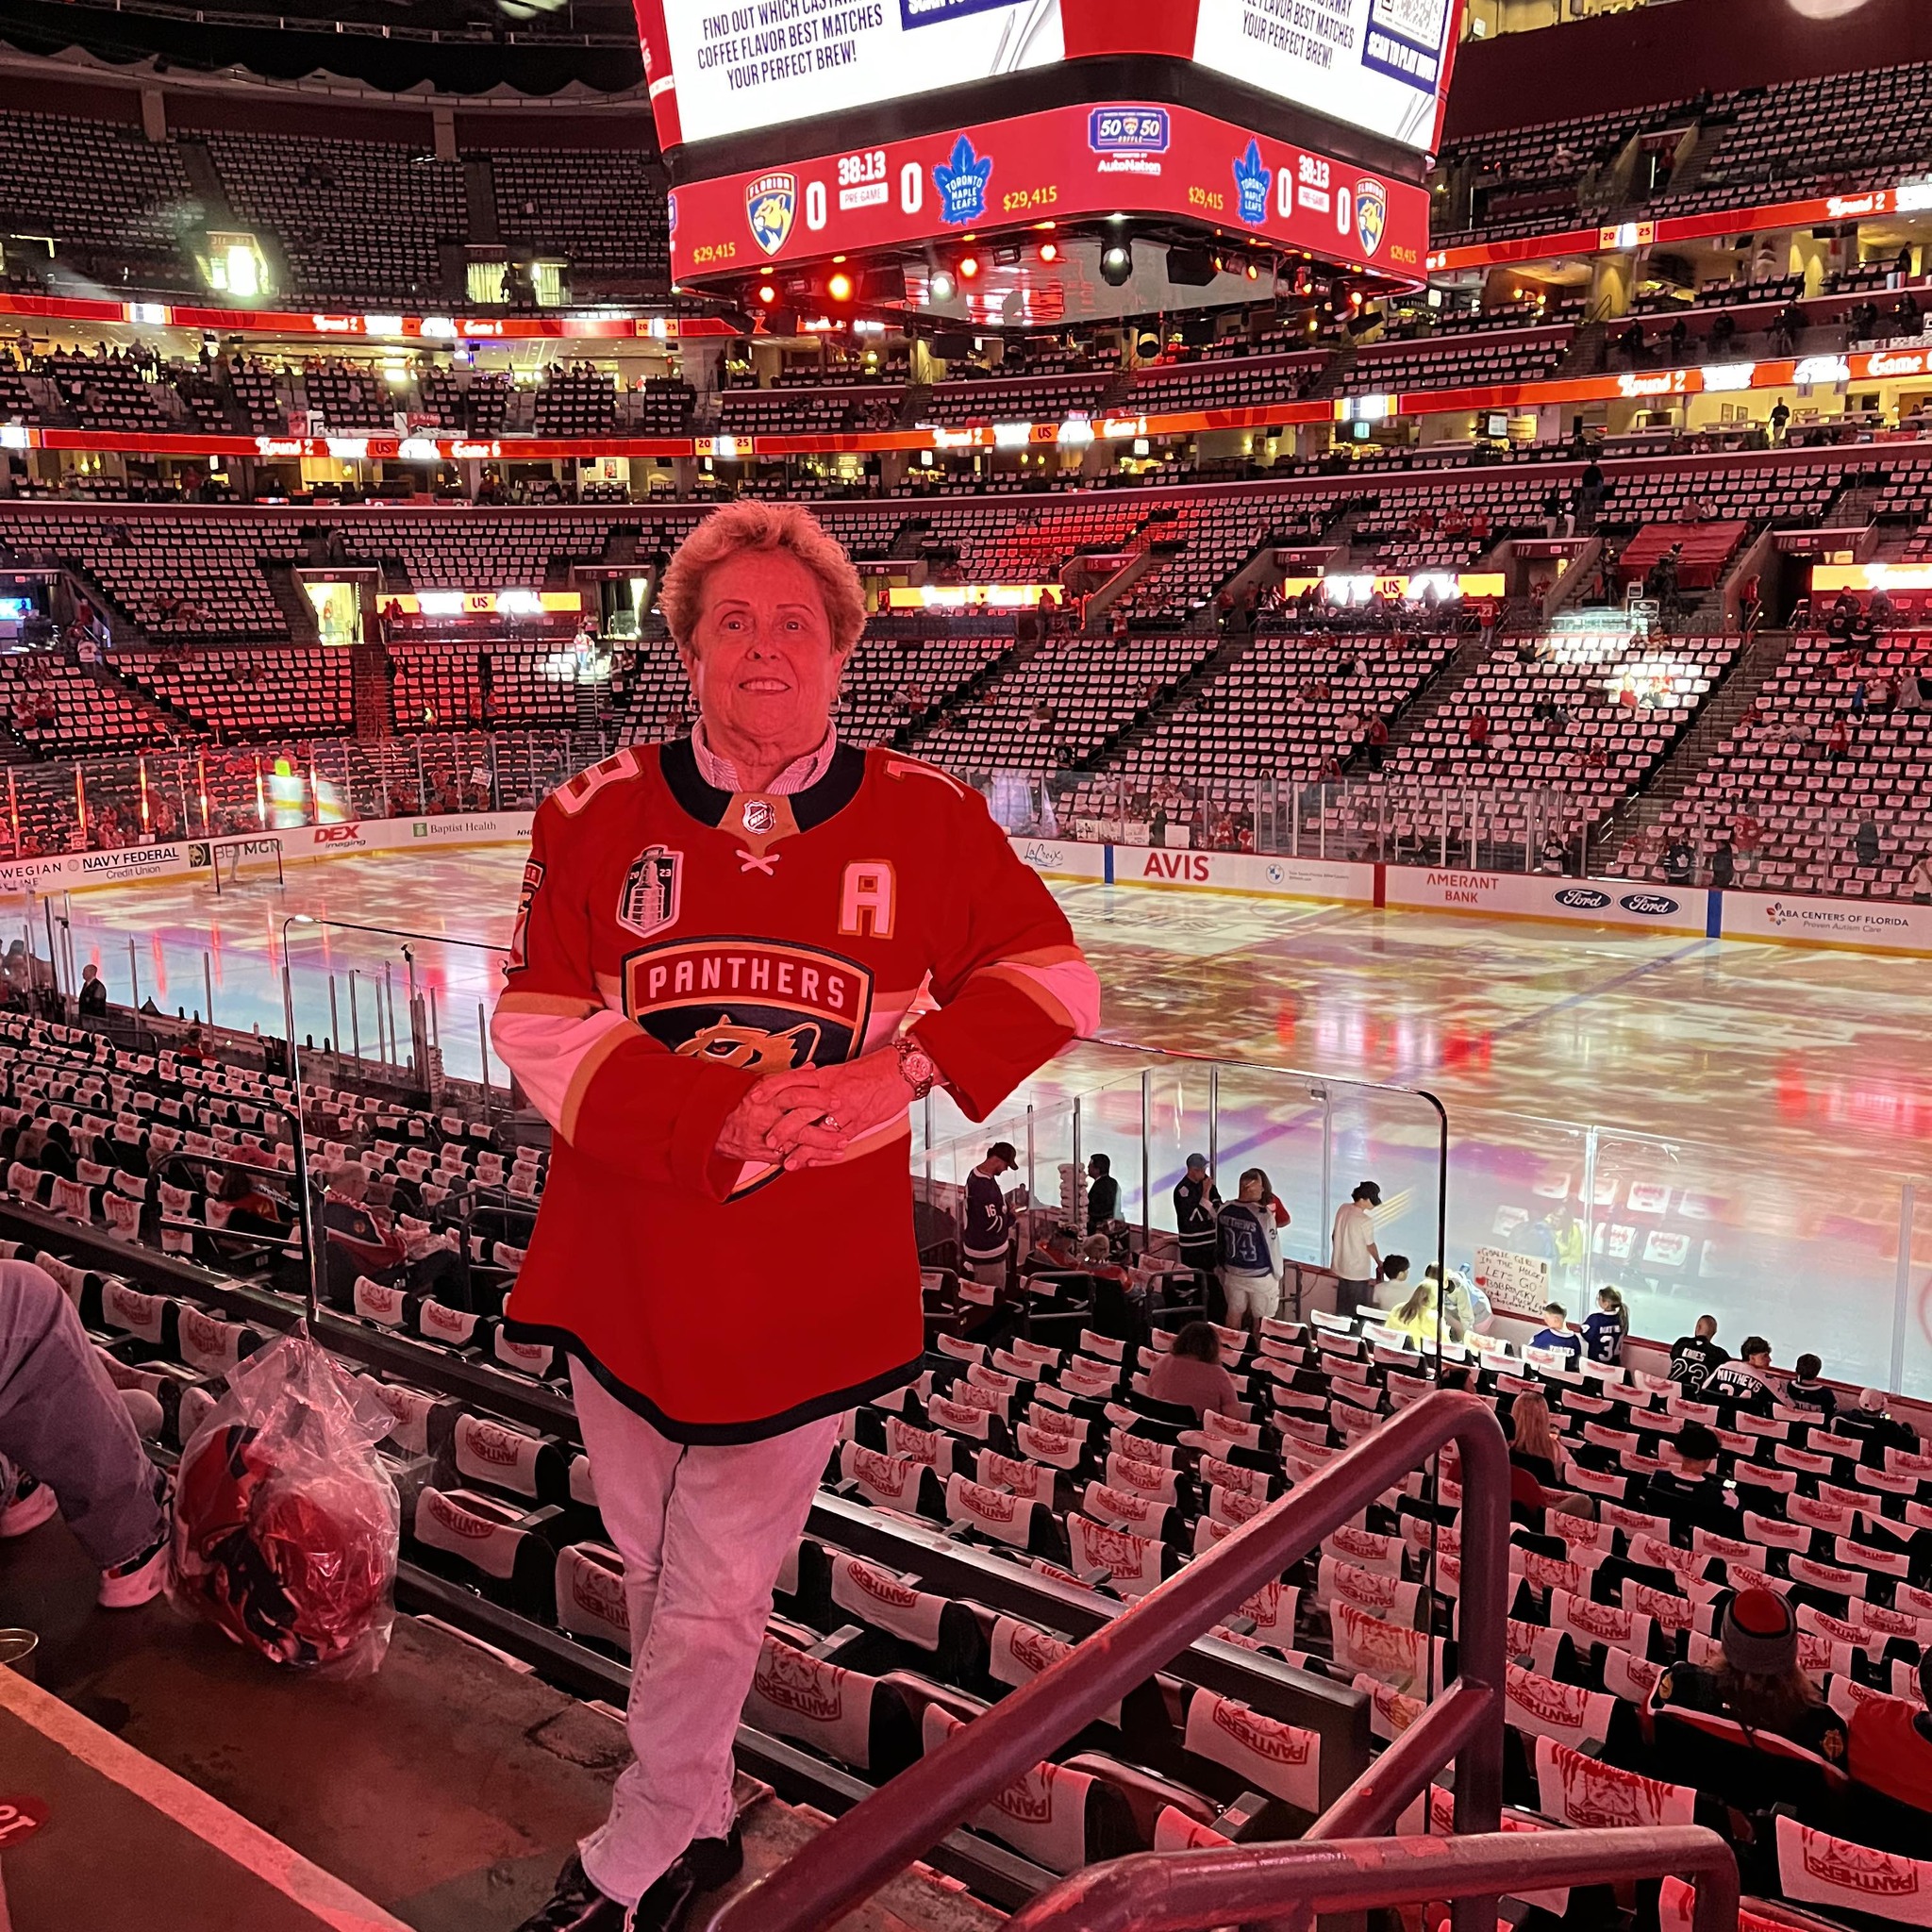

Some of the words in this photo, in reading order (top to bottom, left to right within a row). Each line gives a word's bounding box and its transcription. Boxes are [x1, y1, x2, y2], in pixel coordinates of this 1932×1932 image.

[703, 14, 729, 41] FIND
[732, 7, 755, 33] OUT
[758, 0, 800, 26] WHICH
[1293, 3, 1316, 31] BEST
[1316, 12, 1355, 49] MATCHES
[697, 40, 740, 70] COFFEE
[741, 28, 787, 59] FLAVOR
[789, 20, 819, 47] BEST
[823, 4, 883, 40] MATCHES
[1242, 9, 1267, 43] YOUR
[1267, 21, 1306, 58] PERFECT
[1307, 38, 1333, 71] BREW!
[727, 63, 760, 91] YOUR
[761, 50, 812, 83] PERFECT
[816, 40, 857, 70] BREW!
[1100, 119, 1122, 137] 50
[1140, 119, 1159, 136] 50
[838, 151, 887, 186] 38:13
[1097, 159, 1161, 174] AutoNation
[1298, 154, 1330, 189] 38:13
[749, 177, 791, 197] FLORIDA
[901, 161, 923, 214] 0
[945, 175, 983, 192] TORONTO
[951, 187, 977, 200] MAPLE
[1277, 167, 1292, 218] 0
[807, 181, 826, 231] 0
[951, 197, 977, 210] LEAFS
[1003, 186, 1058, 212] $29,415
[1189, 186, 1224, 210] $29,415
[1874, 192, 1886, 209] 2
[1337, 187, 1351, 235] 0
[1604, 231, 1615, 241] 20
[1639, 228, 1651, 237] 25
[693, 242, 736, 264] $29,415
[1391, 244, 1417, 264] $29,415
[350, 317, 358, 331] 2
[1868, 352, 1924, 375] Game
[1618, 373, 1671, 396] Round
[1674, 370, 1686, 391] 2
[698, 439, 710, 448] 20
[737, 438, 749, 447] 25
[974, 427, 983, 444] 2
[255, 437, 302, 456] Round
[304, 439, 313, 455] 2
[491, 441, 501, 457] 6
[314, 824, 360, 843] DEX
[430, 824, 463, 835] Baptist
[465, 821, 496, 832] Health
[325, 839, 366, 849] imaging
[83, 854, 119, 870] NAVY
[123, 847, 179, 864] FEDERAL
[1143, 852, 1210, 881] AVIS
[106, 869, 134, 879] Credit
[135, 865, 161, 876] Union
[630, 871, 640, 880] 20
[658, 868, 672, 878] 23
[1426, 874, 1499, 890] AMERANT
[840, 859, 895, 939] A
[1445, 890, 1478, 904] BANK
[1562, 889, 1604, 908] Ford
[1627, 894, 1671, 914] Ford
[1778, 909, 1799, 919] ABA
[1802, 911, 1845, 922] CENTERS
[1848, 914, 1862, 924] OF
[1865, 916, 1909, 926] FLORIDA
[1803, 920, 1831, 929] Proven
[1832, 924, 1860, 932] Autism
[1863, 924, 1882, 933] Care
[649, 956, 844, 1009] PANTHERS
[985, 1204, 996, 1218] 16
[1497, 1259, 1513, 1269] THE
[1519, 1277, 1537, 1291] GO
[1717, 1369, 1763, 1393] MATTHEWS
[851, 1562, 914, 1604] PANTHERS
[758, 1673, 838, 1716] PANTHERS
[1507, 1685, 1580, 1724] PANTHERS
[1217, 1708, 1304, 1761] PANTHERS
[1808, 1857, 1913, 1890] PANTHERS
